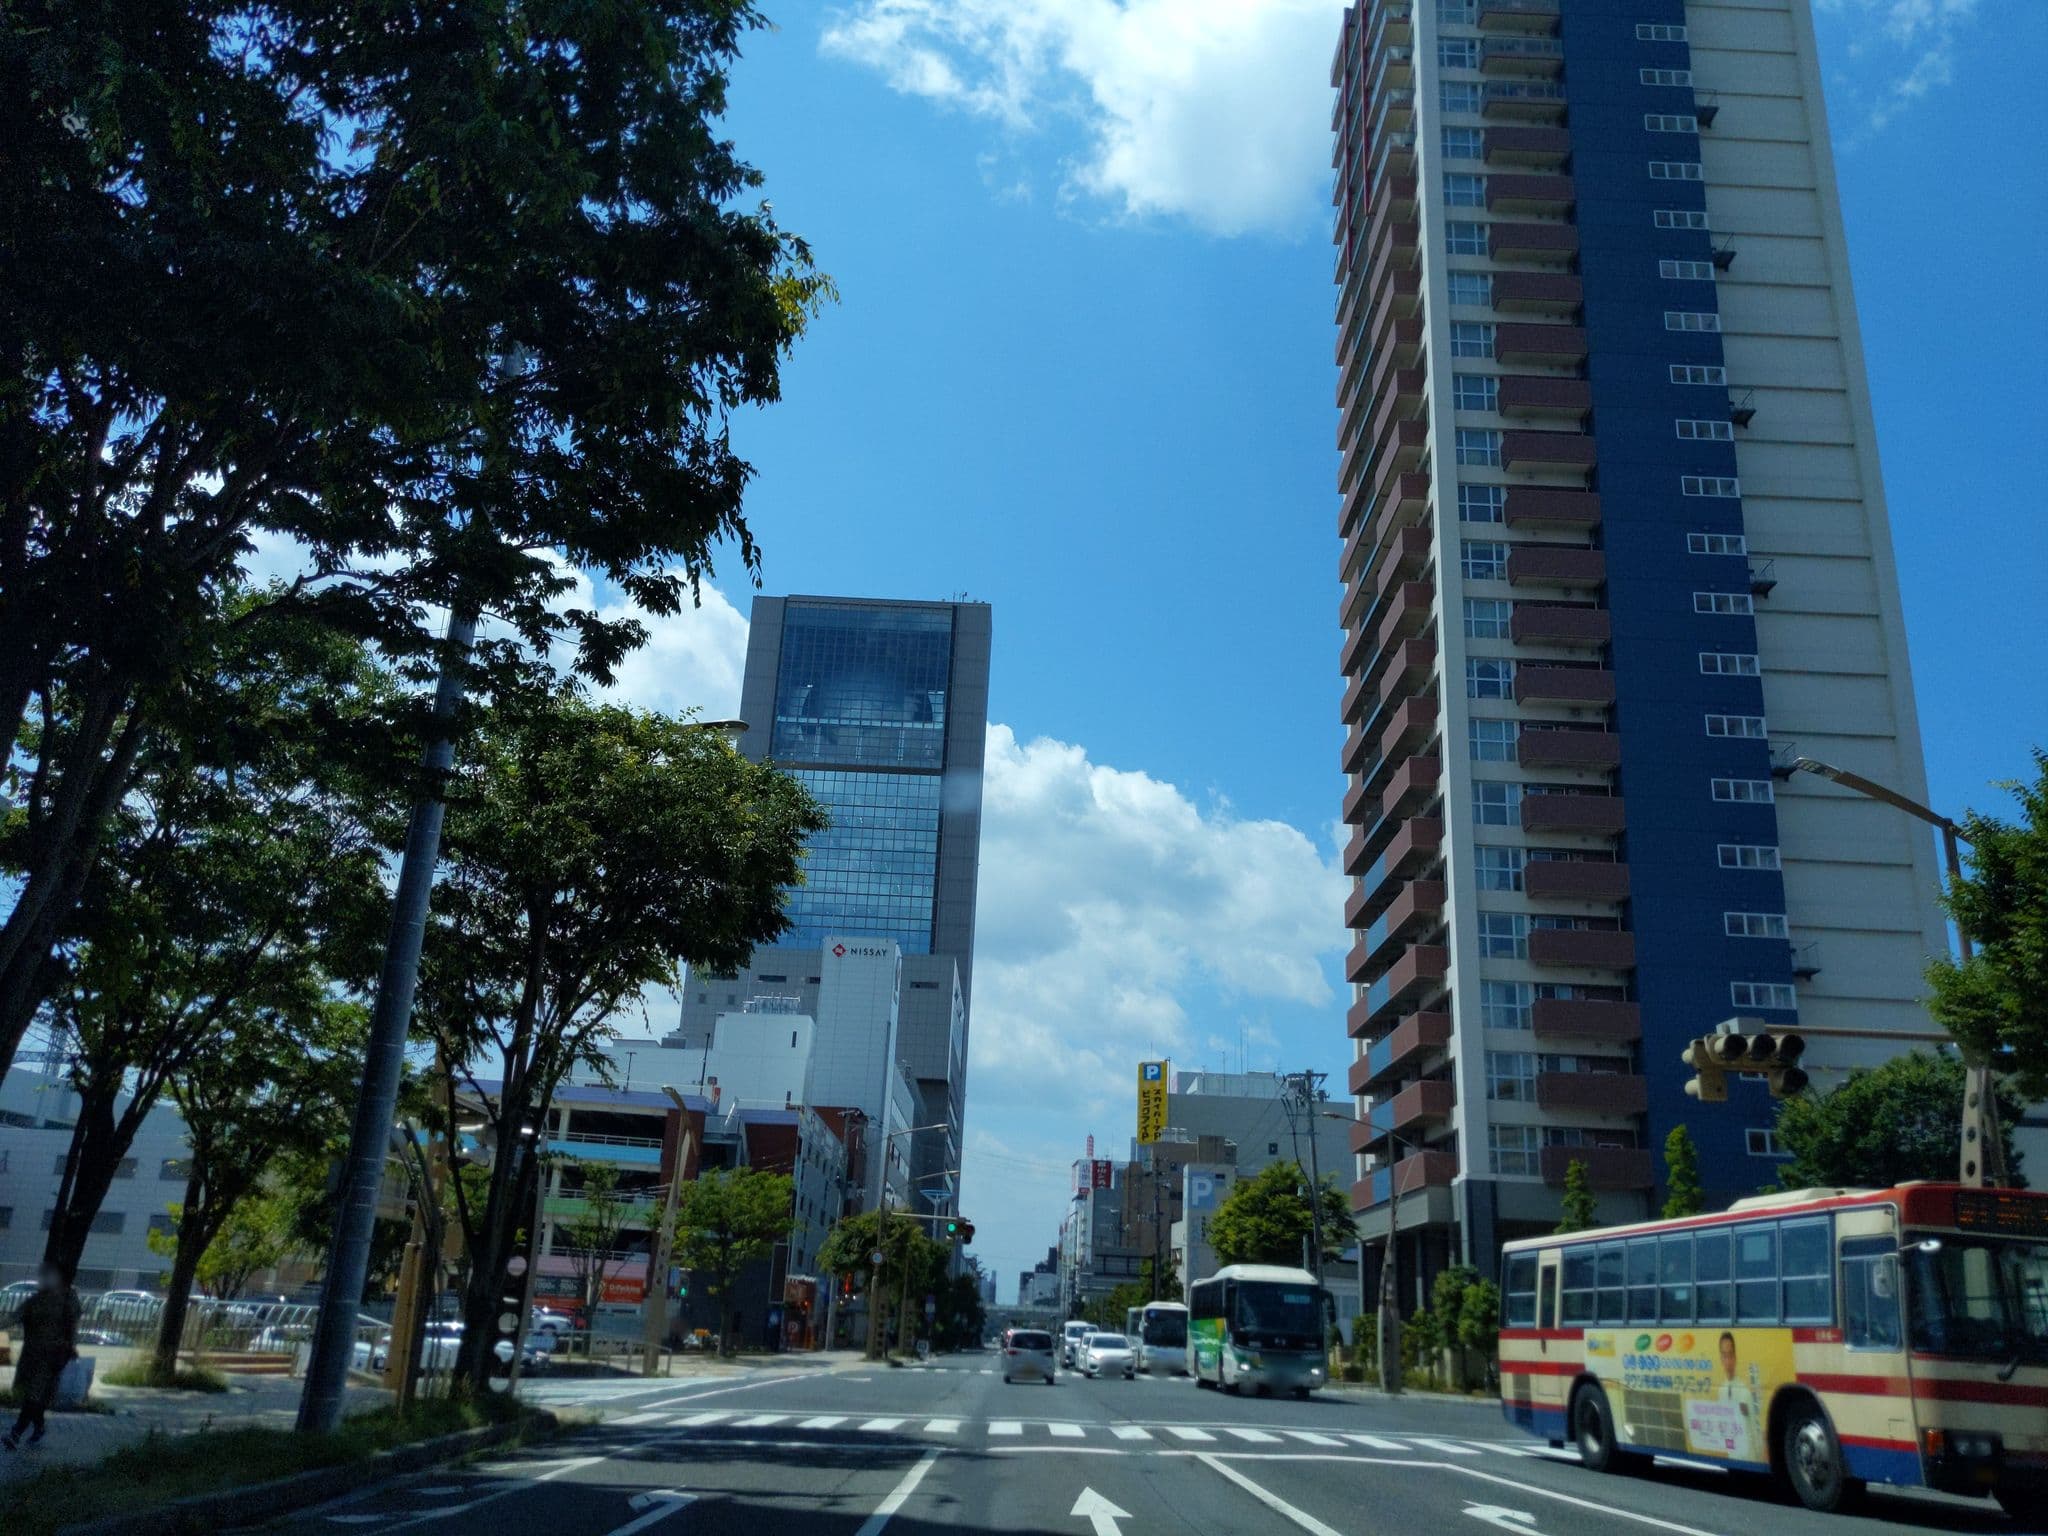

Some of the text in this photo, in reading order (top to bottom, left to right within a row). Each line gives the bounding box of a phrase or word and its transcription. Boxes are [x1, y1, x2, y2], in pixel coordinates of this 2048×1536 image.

[850, 947, 887, 957] NISSAY
[1146, 1065, 1159, 1080] P
[1192, 1176, 1213, 1206] P
